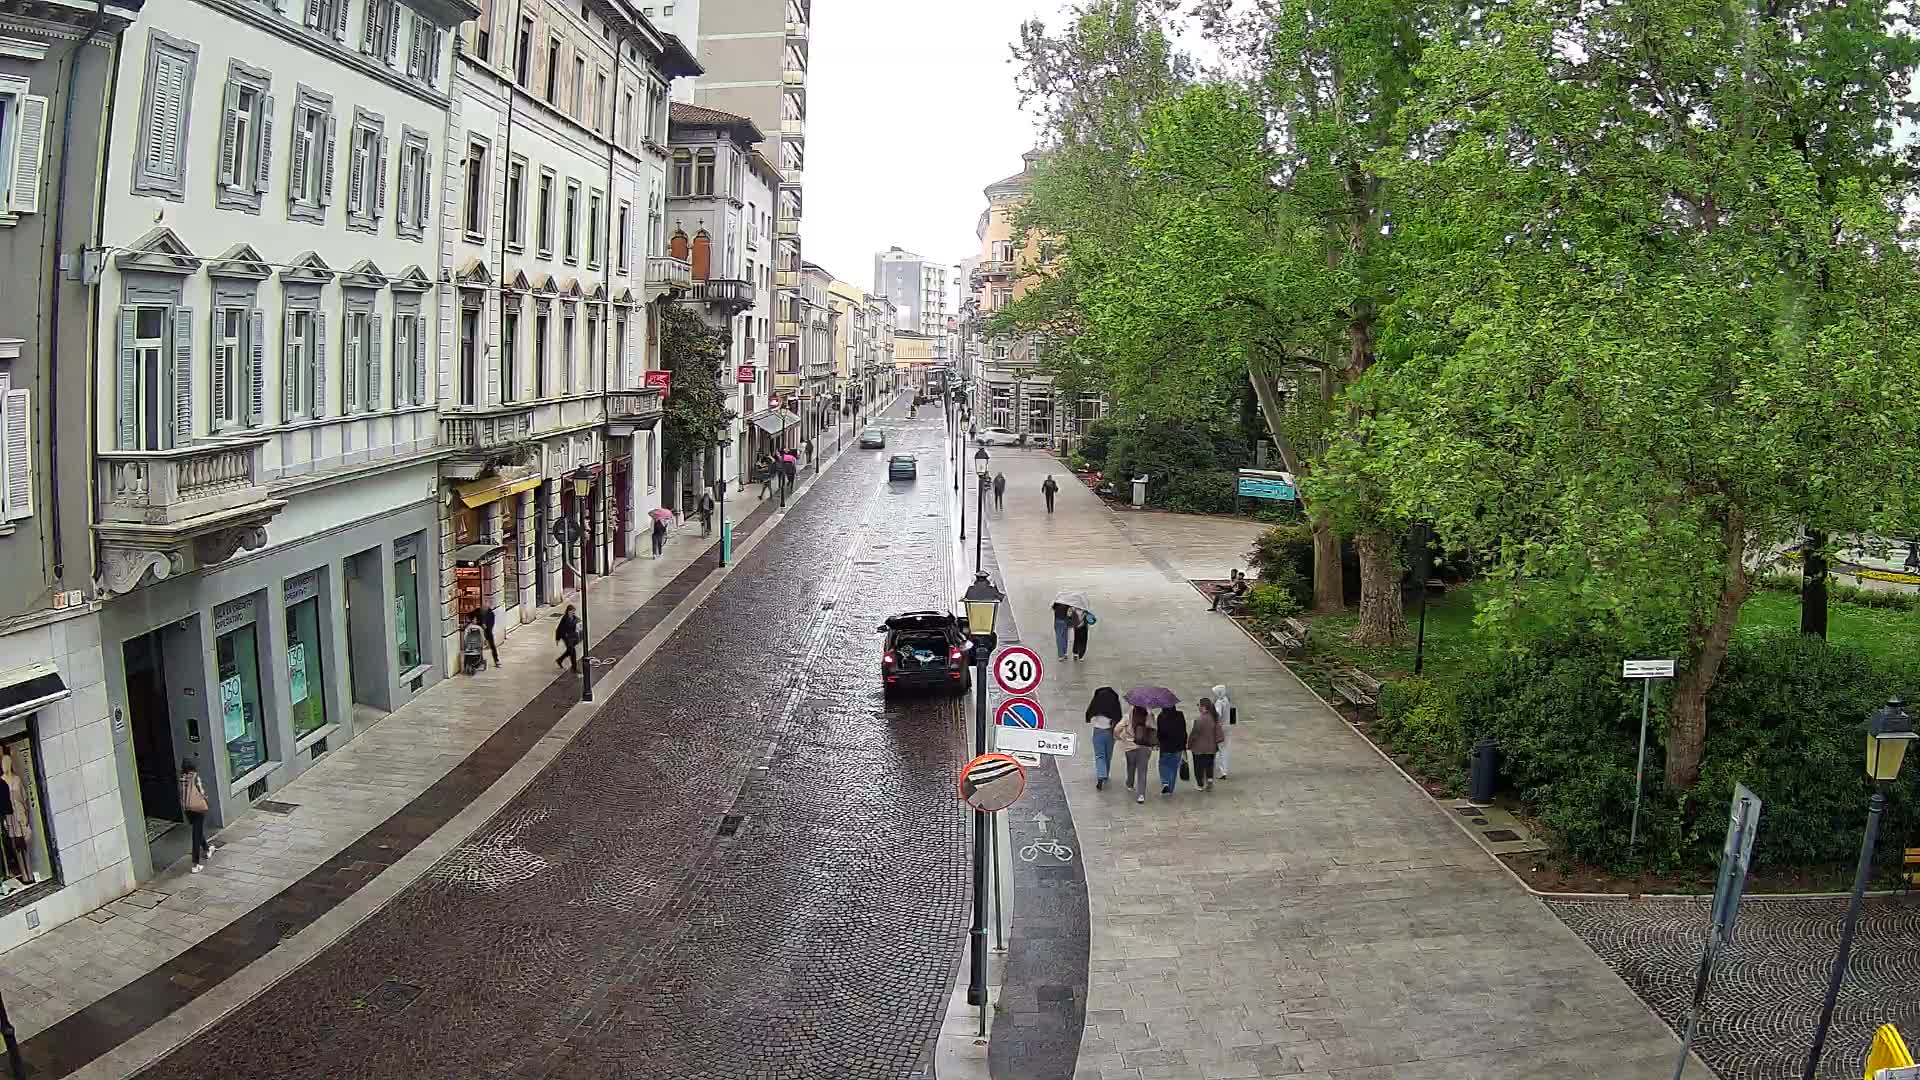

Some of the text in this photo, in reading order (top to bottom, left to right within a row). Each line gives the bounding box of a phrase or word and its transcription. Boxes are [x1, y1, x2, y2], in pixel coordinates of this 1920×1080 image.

[1005, 660, 1032, 681] 30
[221, 679, 240, 701] 130
[1038, 740, 1069, 751] Dante
